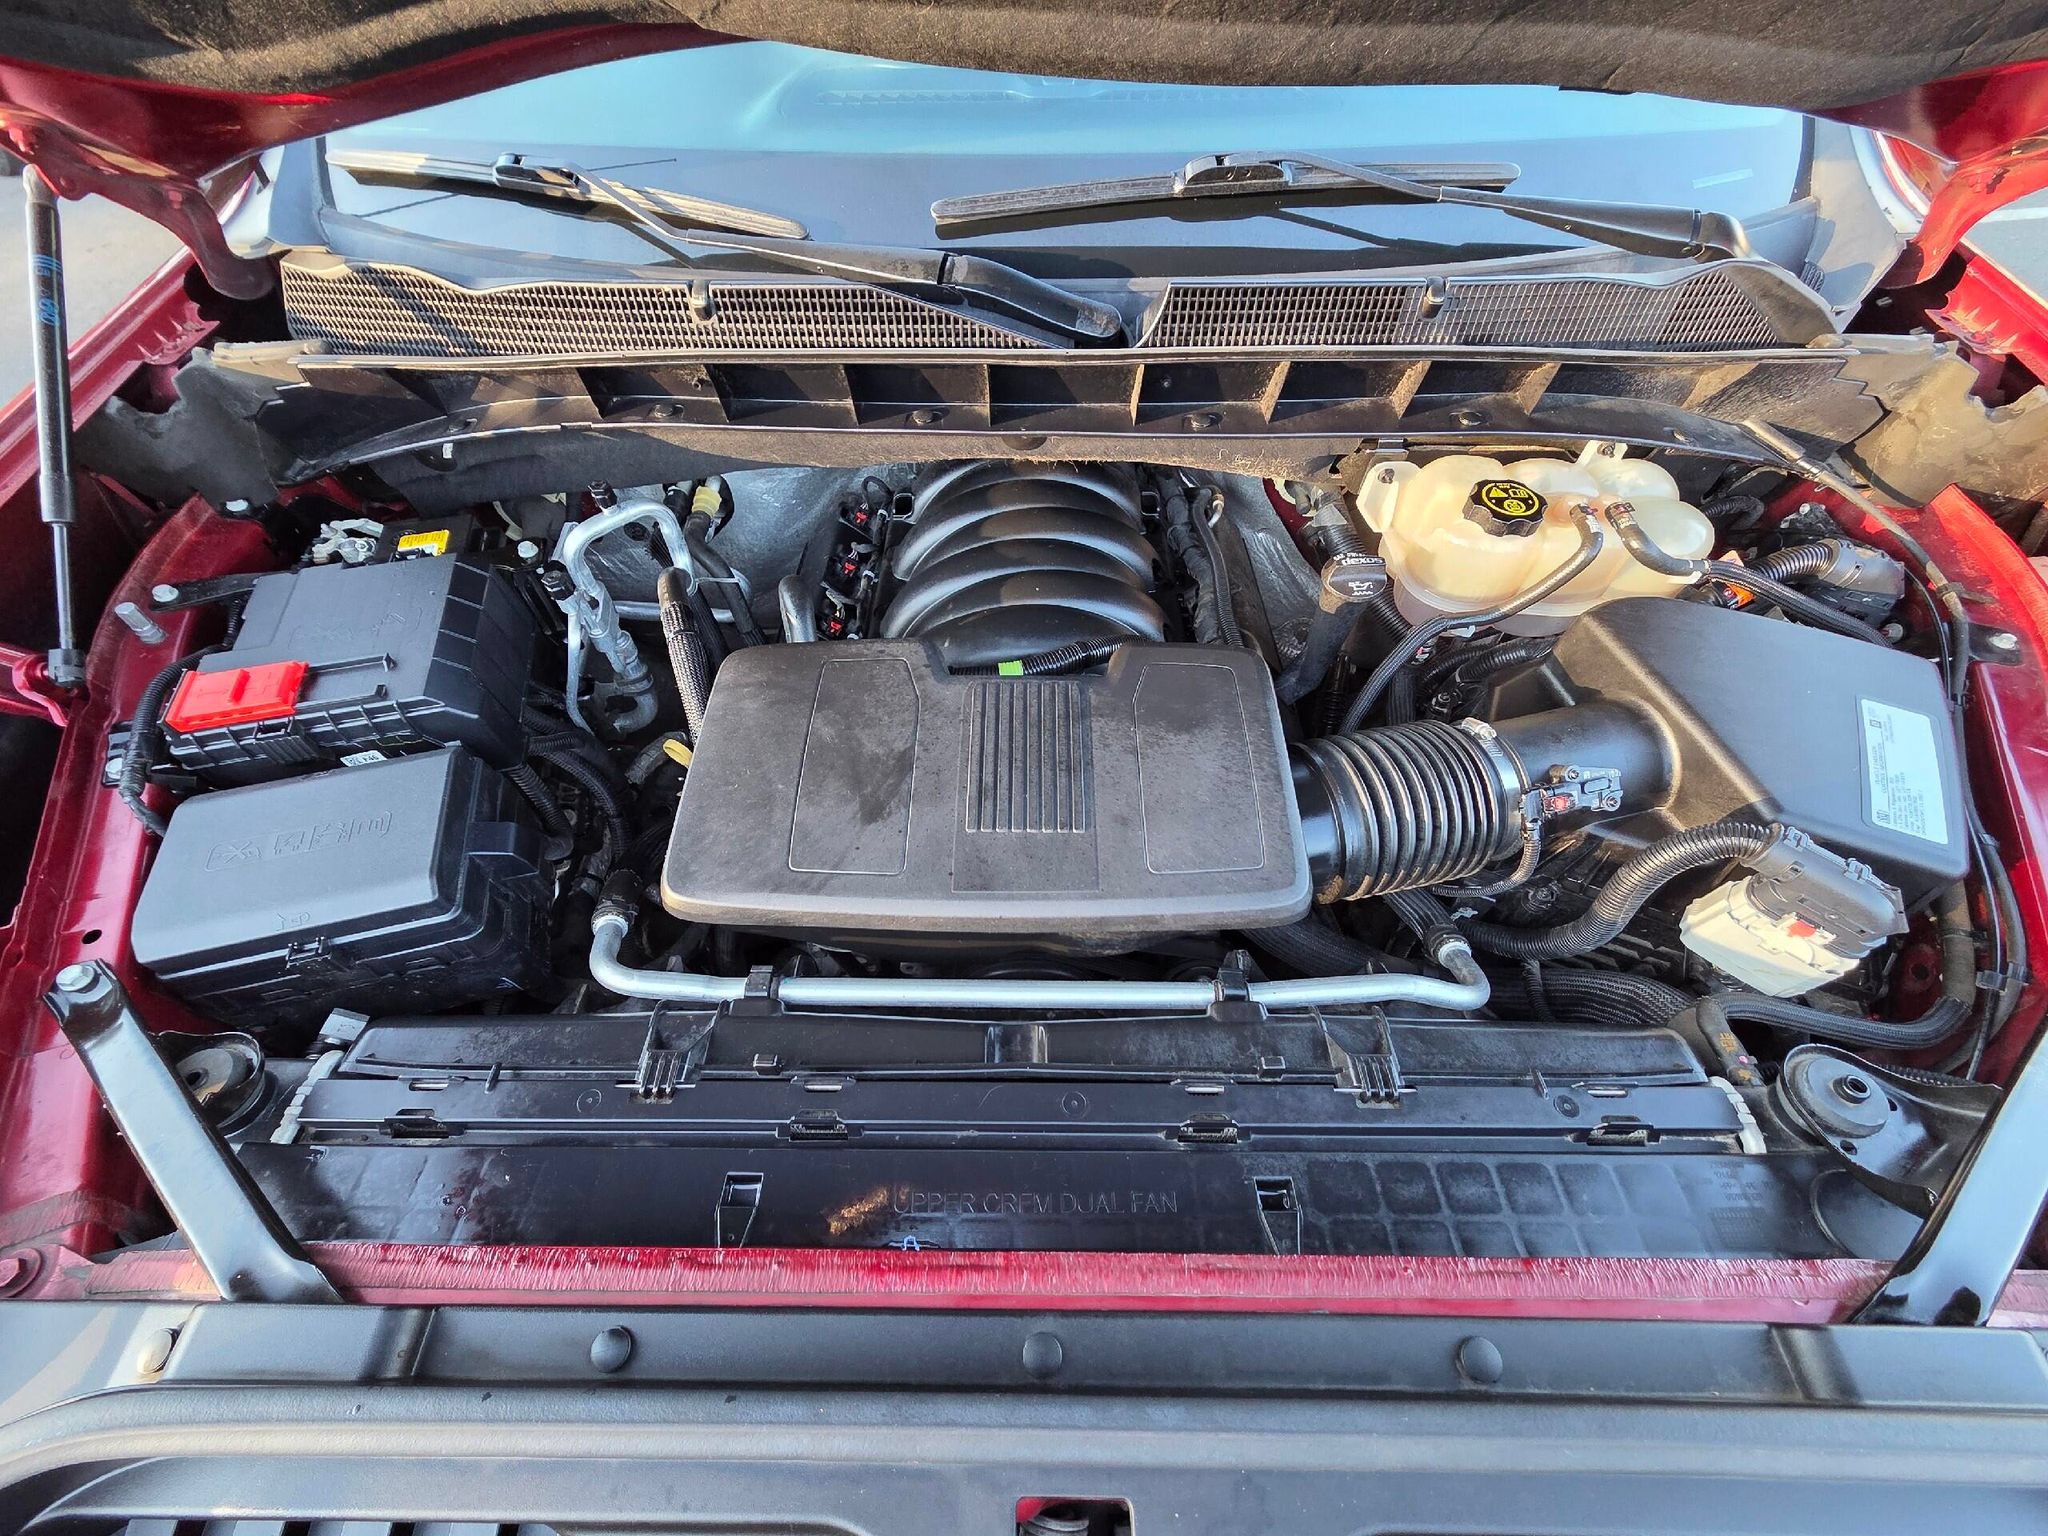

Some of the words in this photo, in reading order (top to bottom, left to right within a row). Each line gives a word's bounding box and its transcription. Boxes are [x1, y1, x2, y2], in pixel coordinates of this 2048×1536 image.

[892, 1190, 976, 1214] UPPER
[1059, 1191, 1126, 1214] DUAL
[1129, 1190, 1179, 1214] FAN
